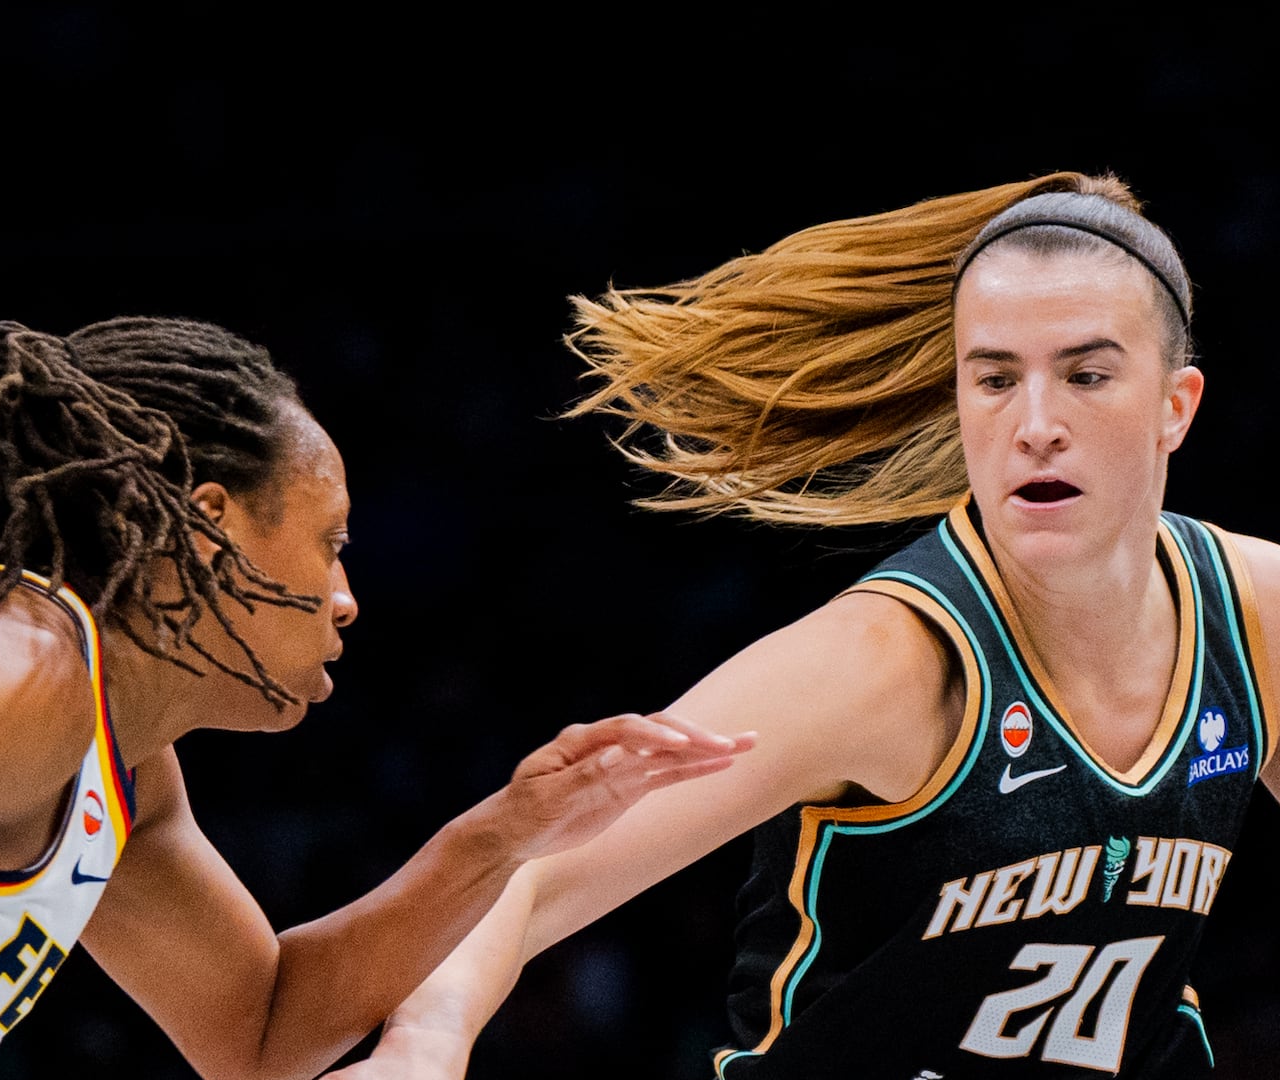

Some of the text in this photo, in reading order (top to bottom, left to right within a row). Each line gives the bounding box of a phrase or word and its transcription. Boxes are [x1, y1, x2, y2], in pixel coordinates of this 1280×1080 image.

[921, 836, 1233, 940] NEW YOR
[958, 935, 1166, 1075] 20
